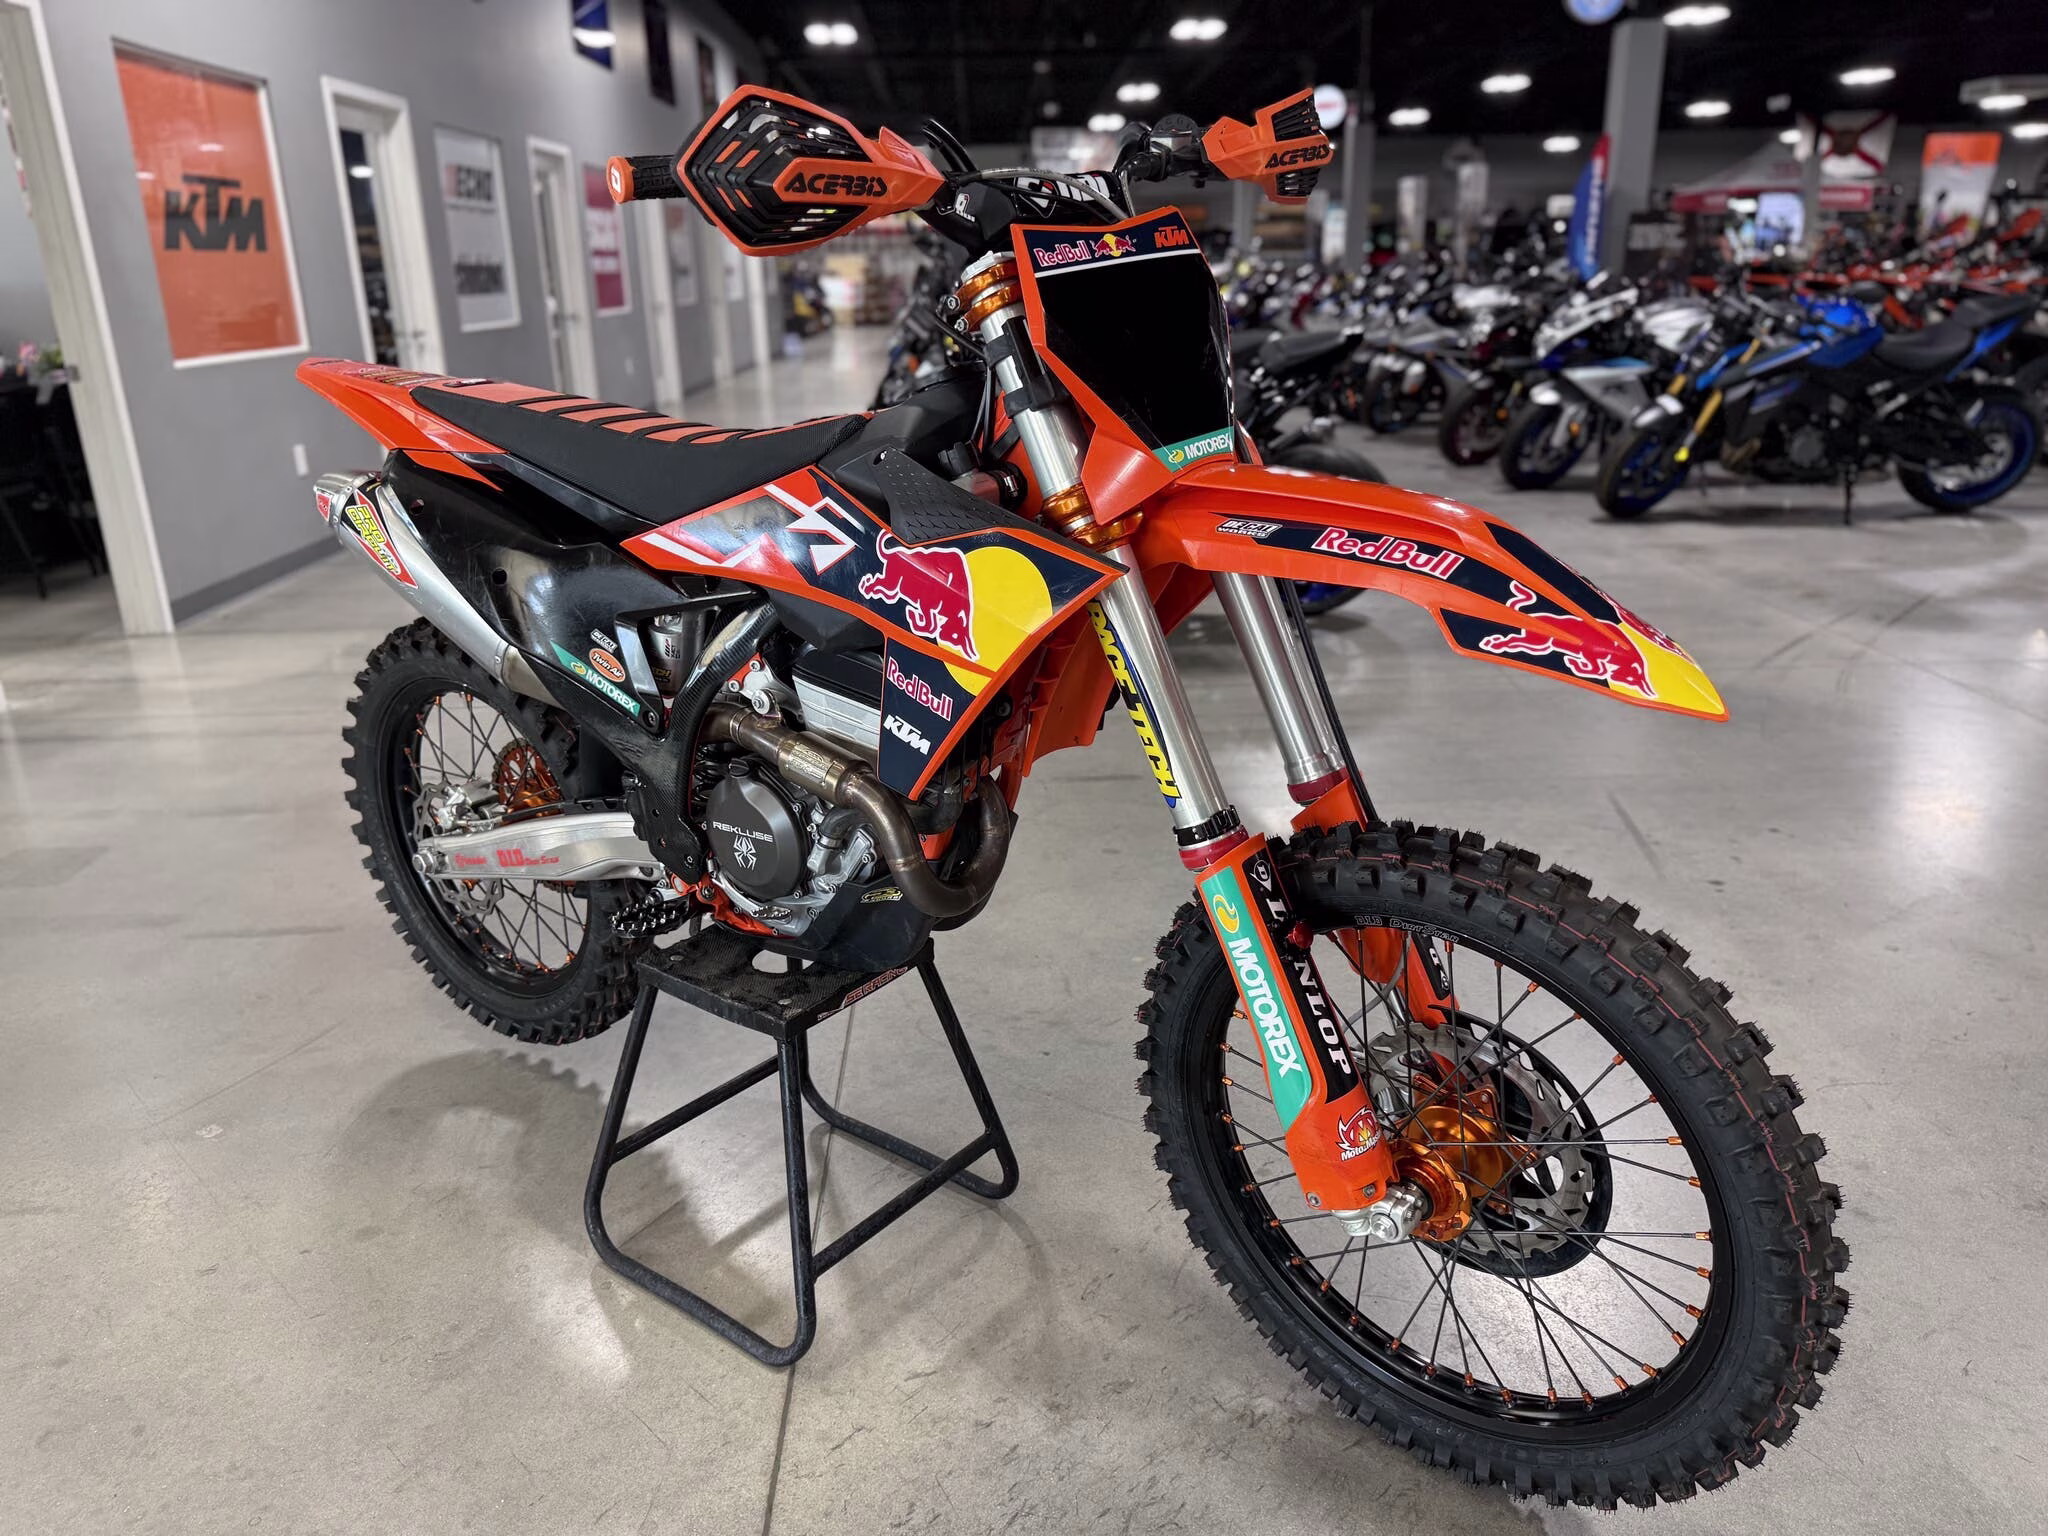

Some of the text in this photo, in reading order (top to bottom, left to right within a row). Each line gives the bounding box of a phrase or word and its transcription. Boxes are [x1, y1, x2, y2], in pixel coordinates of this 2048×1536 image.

[1265, 144, 1330, 168] ACERBIS
[784, 172, 888, 197] ACERBIS
[164, 174, 267, 252] KTM
[1154, 226, 1189, 248] KTM
[1184, 433, 1231, 459] MOTOREX
[358, 505, 386, 544] PRO
[592, 652, 624, 679] Twin Air
[585, 669, 635, 714] MOTOREX
[1088, 602, 1182, 798] RACE TECH
[883, 714, 931, 755] KTM
[713, 821, 774, 843] REKLUSE
[1228, 937, 1303, 1078] MOTOREX
